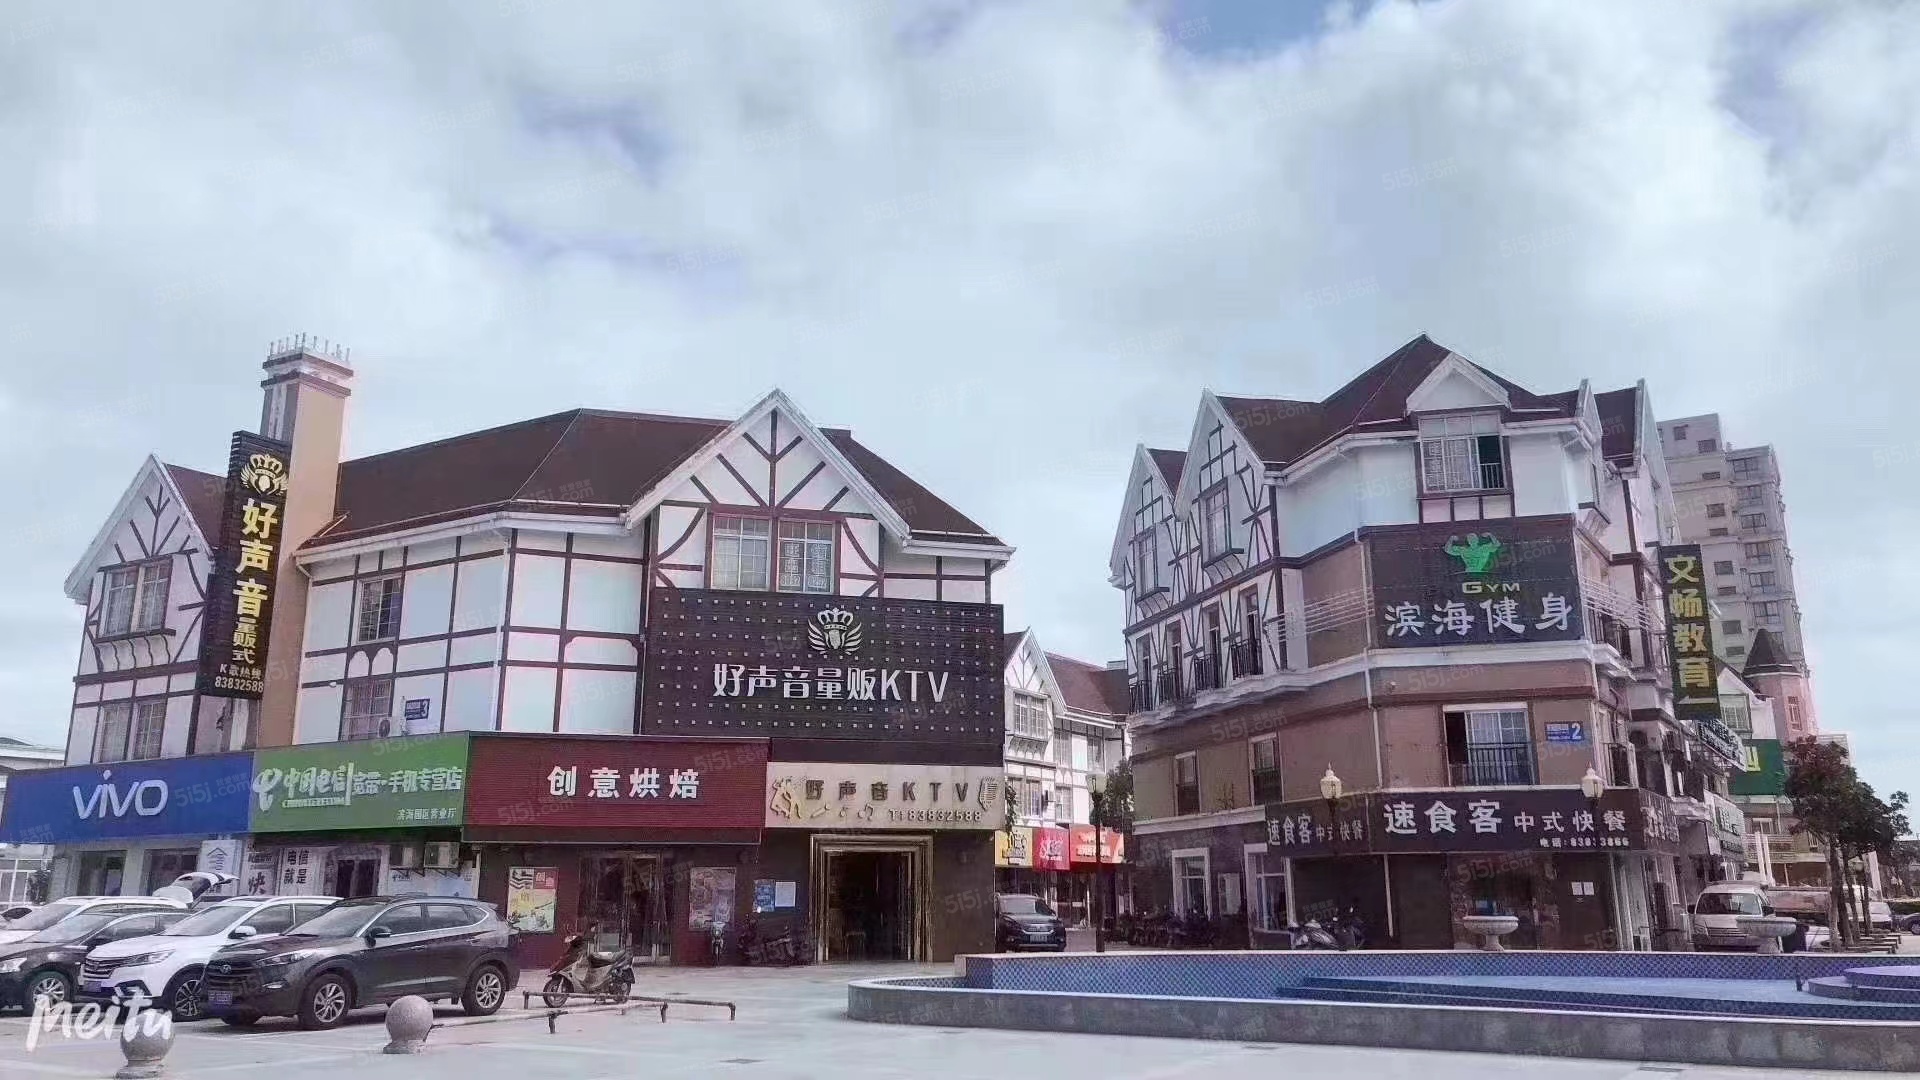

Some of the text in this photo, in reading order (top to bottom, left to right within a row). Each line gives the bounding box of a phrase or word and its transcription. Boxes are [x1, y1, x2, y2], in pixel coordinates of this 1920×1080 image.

[233, 497, 278, 617] 好声音
[1462, 581, 1521, 594] GYM
[1384, 592, 1573, 637] 滨海健身
[1664, 554, 1711, 688] 文畅教育
[214, 675, 265, 693] 83832588
[712, 663, 950, 703] 好声音量贩KTV
[1571, 722, 1582, 740] 2
[283, 765, 346, 798] 中国电信
[547, 765, 700, 799] 创意烘焙
[1266, 813, 1312, 846] 速食客
[1383, 799, 1503, 835] 速食客
[1513, 809, 1627, 833] 中式快餐
